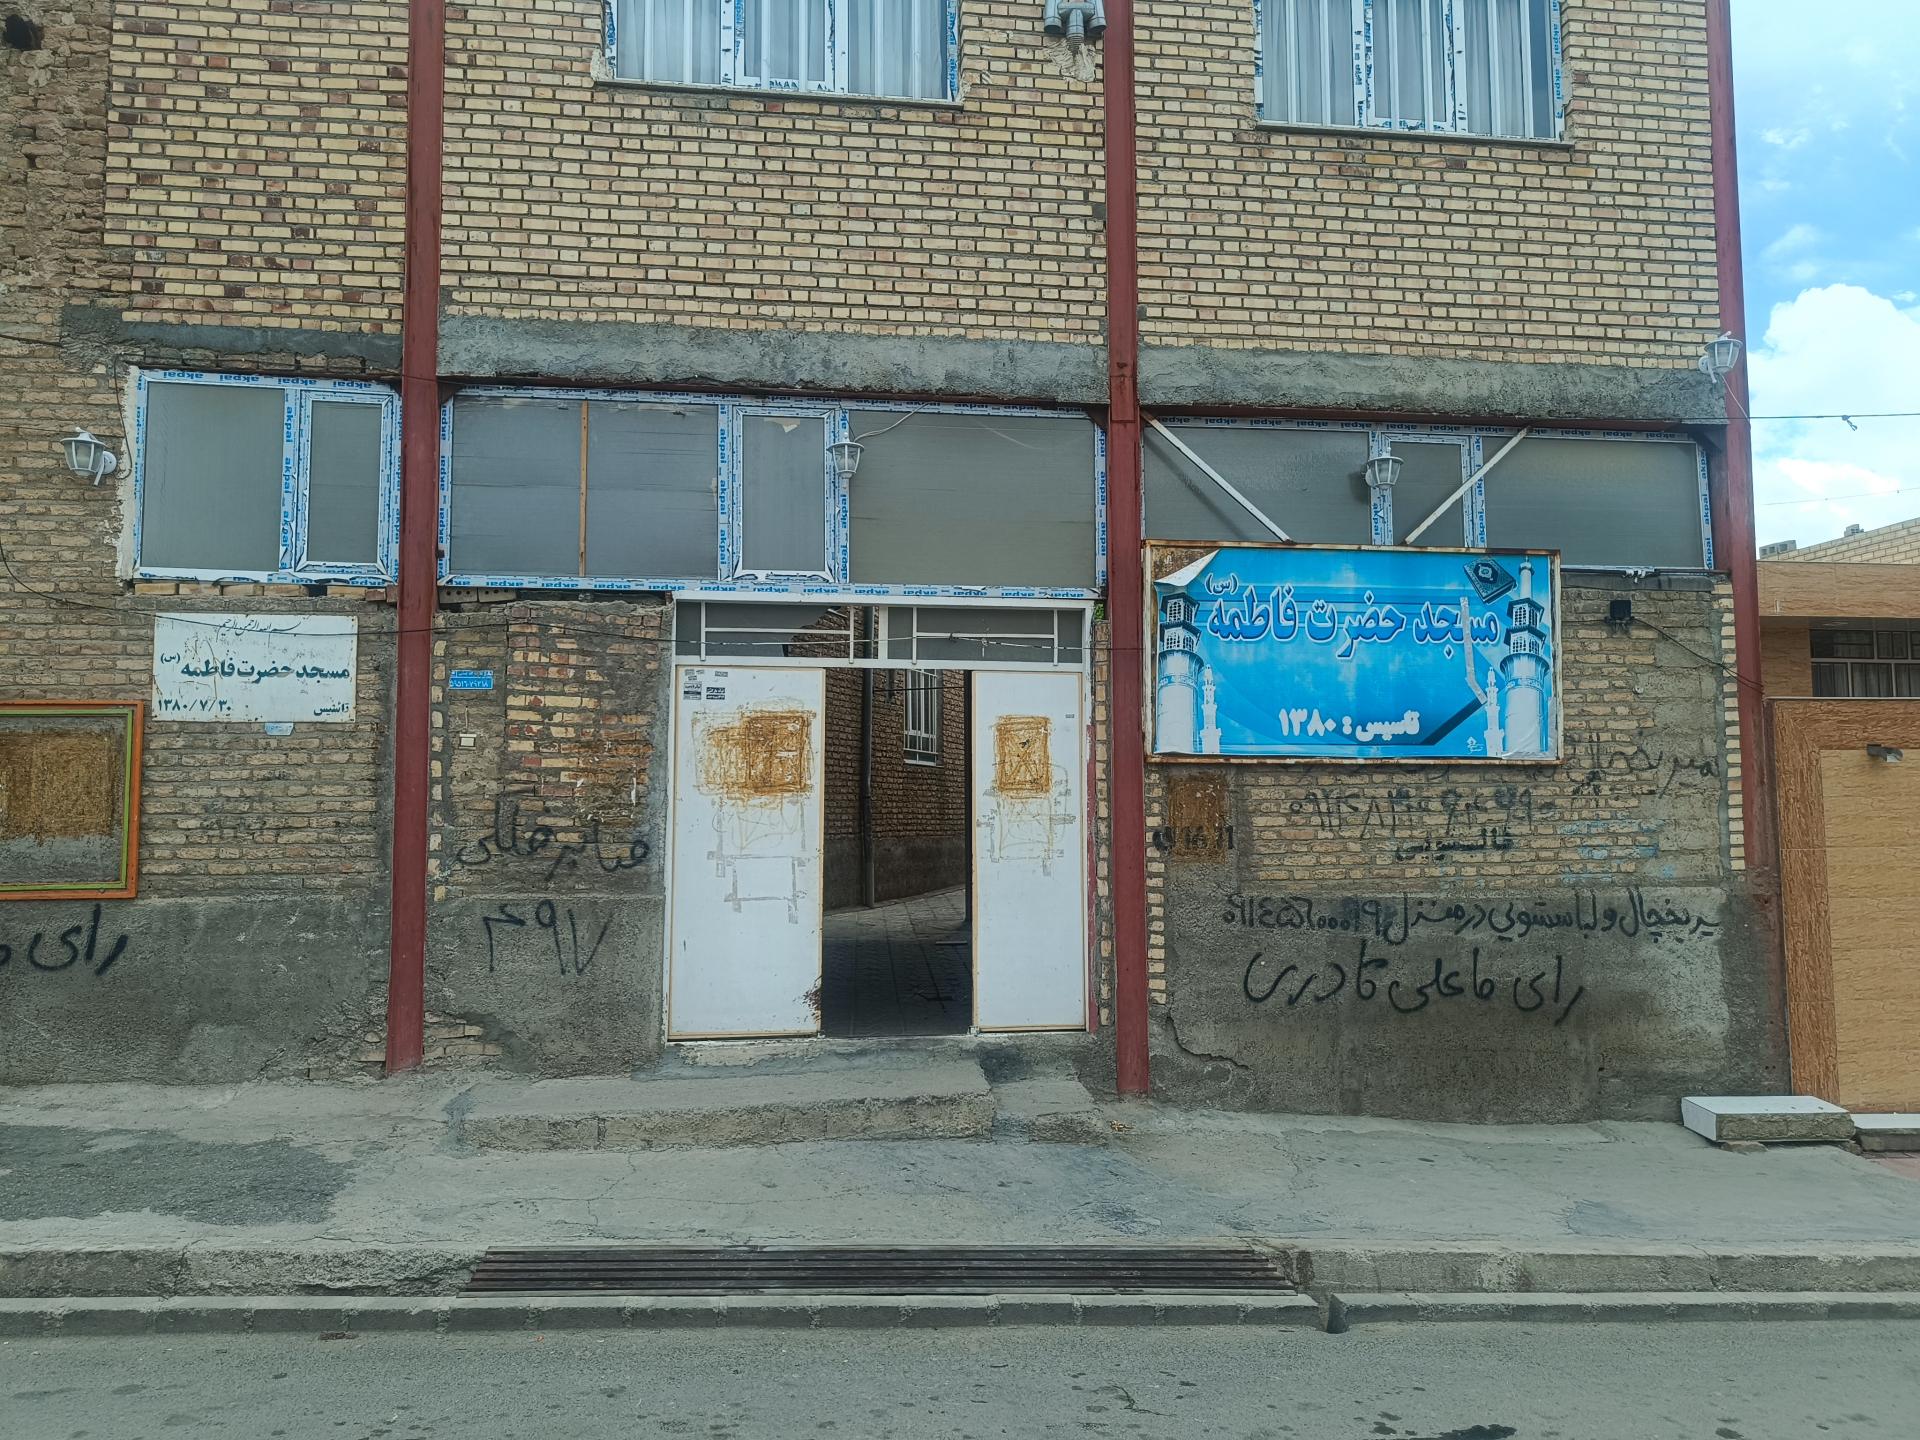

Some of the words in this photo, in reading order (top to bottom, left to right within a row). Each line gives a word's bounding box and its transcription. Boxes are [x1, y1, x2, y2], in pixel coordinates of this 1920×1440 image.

[1204, 572, 1239, 595] (س)
[1207, 583, 1299, 642] فاطمه
[1305, 590, 1406, 660] حضرت
[1413, 601, 1501, 660] مسجد
[180, 657, 236, 678] فاطمه
[236, 660, 295, 684] حضرت
[296, 664, 350, 684] مسجد
[1278, 708, 1336, 737] ۱۳۸۰
[27, 902, 129, 977] رای
[1388, 957, 1465, 1014] علی
[1472, 946, 1496, 1000] ما
[1513, 954, 1584, 1027] رای
